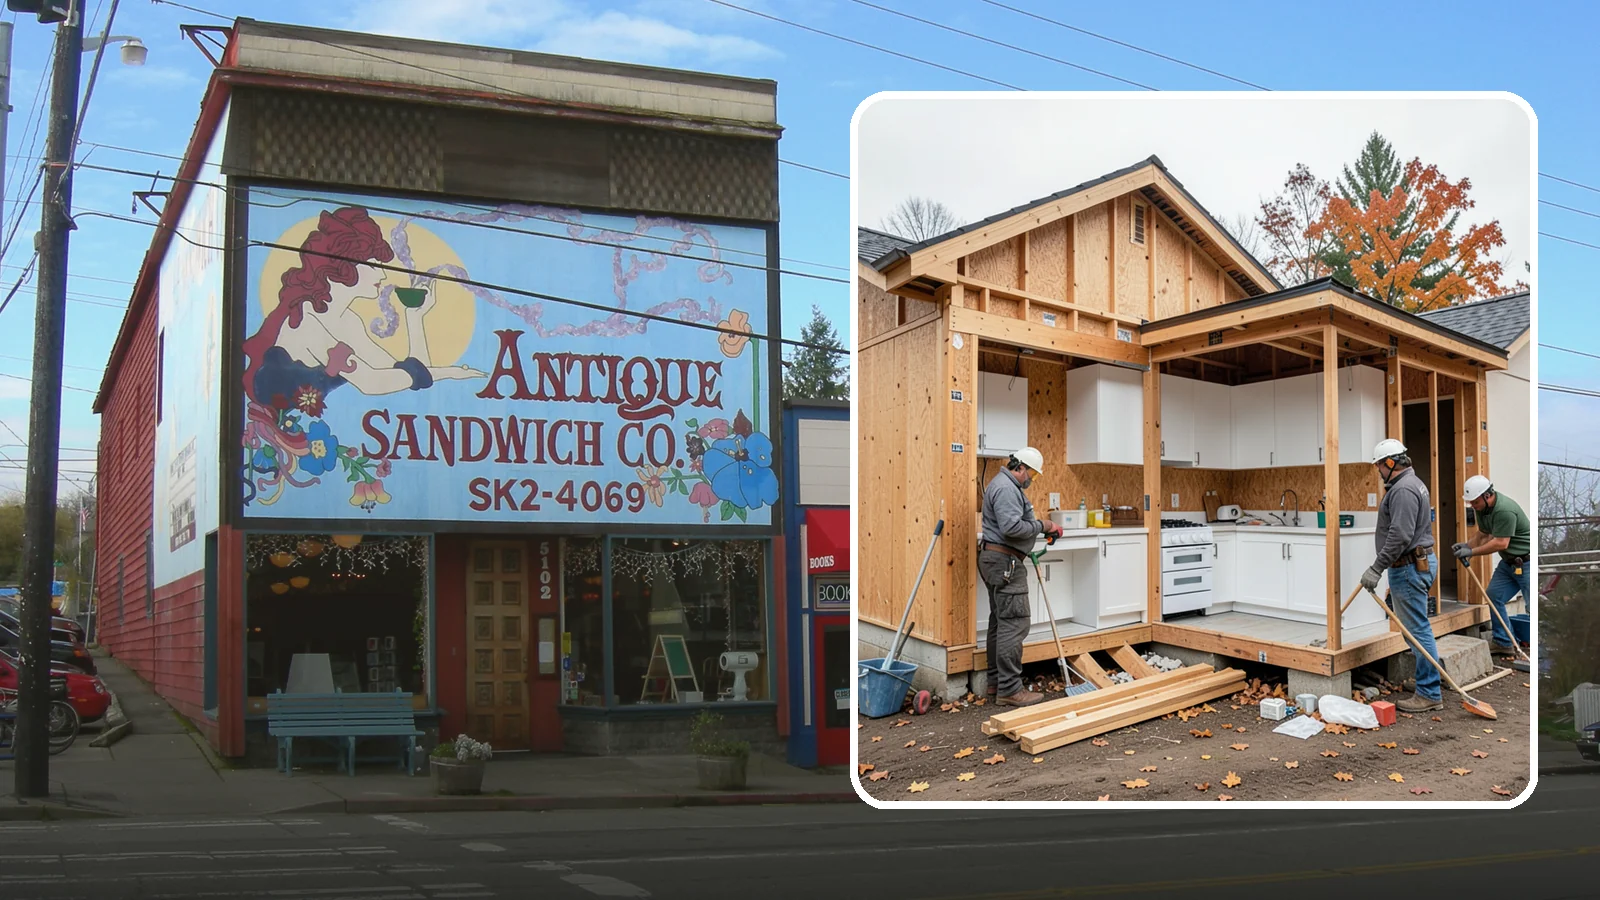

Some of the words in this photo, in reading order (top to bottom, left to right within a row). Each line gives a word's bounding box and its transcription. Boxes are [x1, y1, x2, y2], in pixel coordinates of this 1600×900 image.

[476, 329, 723, 420] ANTIQUE
[362, 408, 604, 467] SANDWICH
[617, 422, 685, 468] CO.
[468, 477, 646, 513] SK2-4069
[539, 542, 552, 599] 5102
[809, 555, 835, 568] BOOKS
